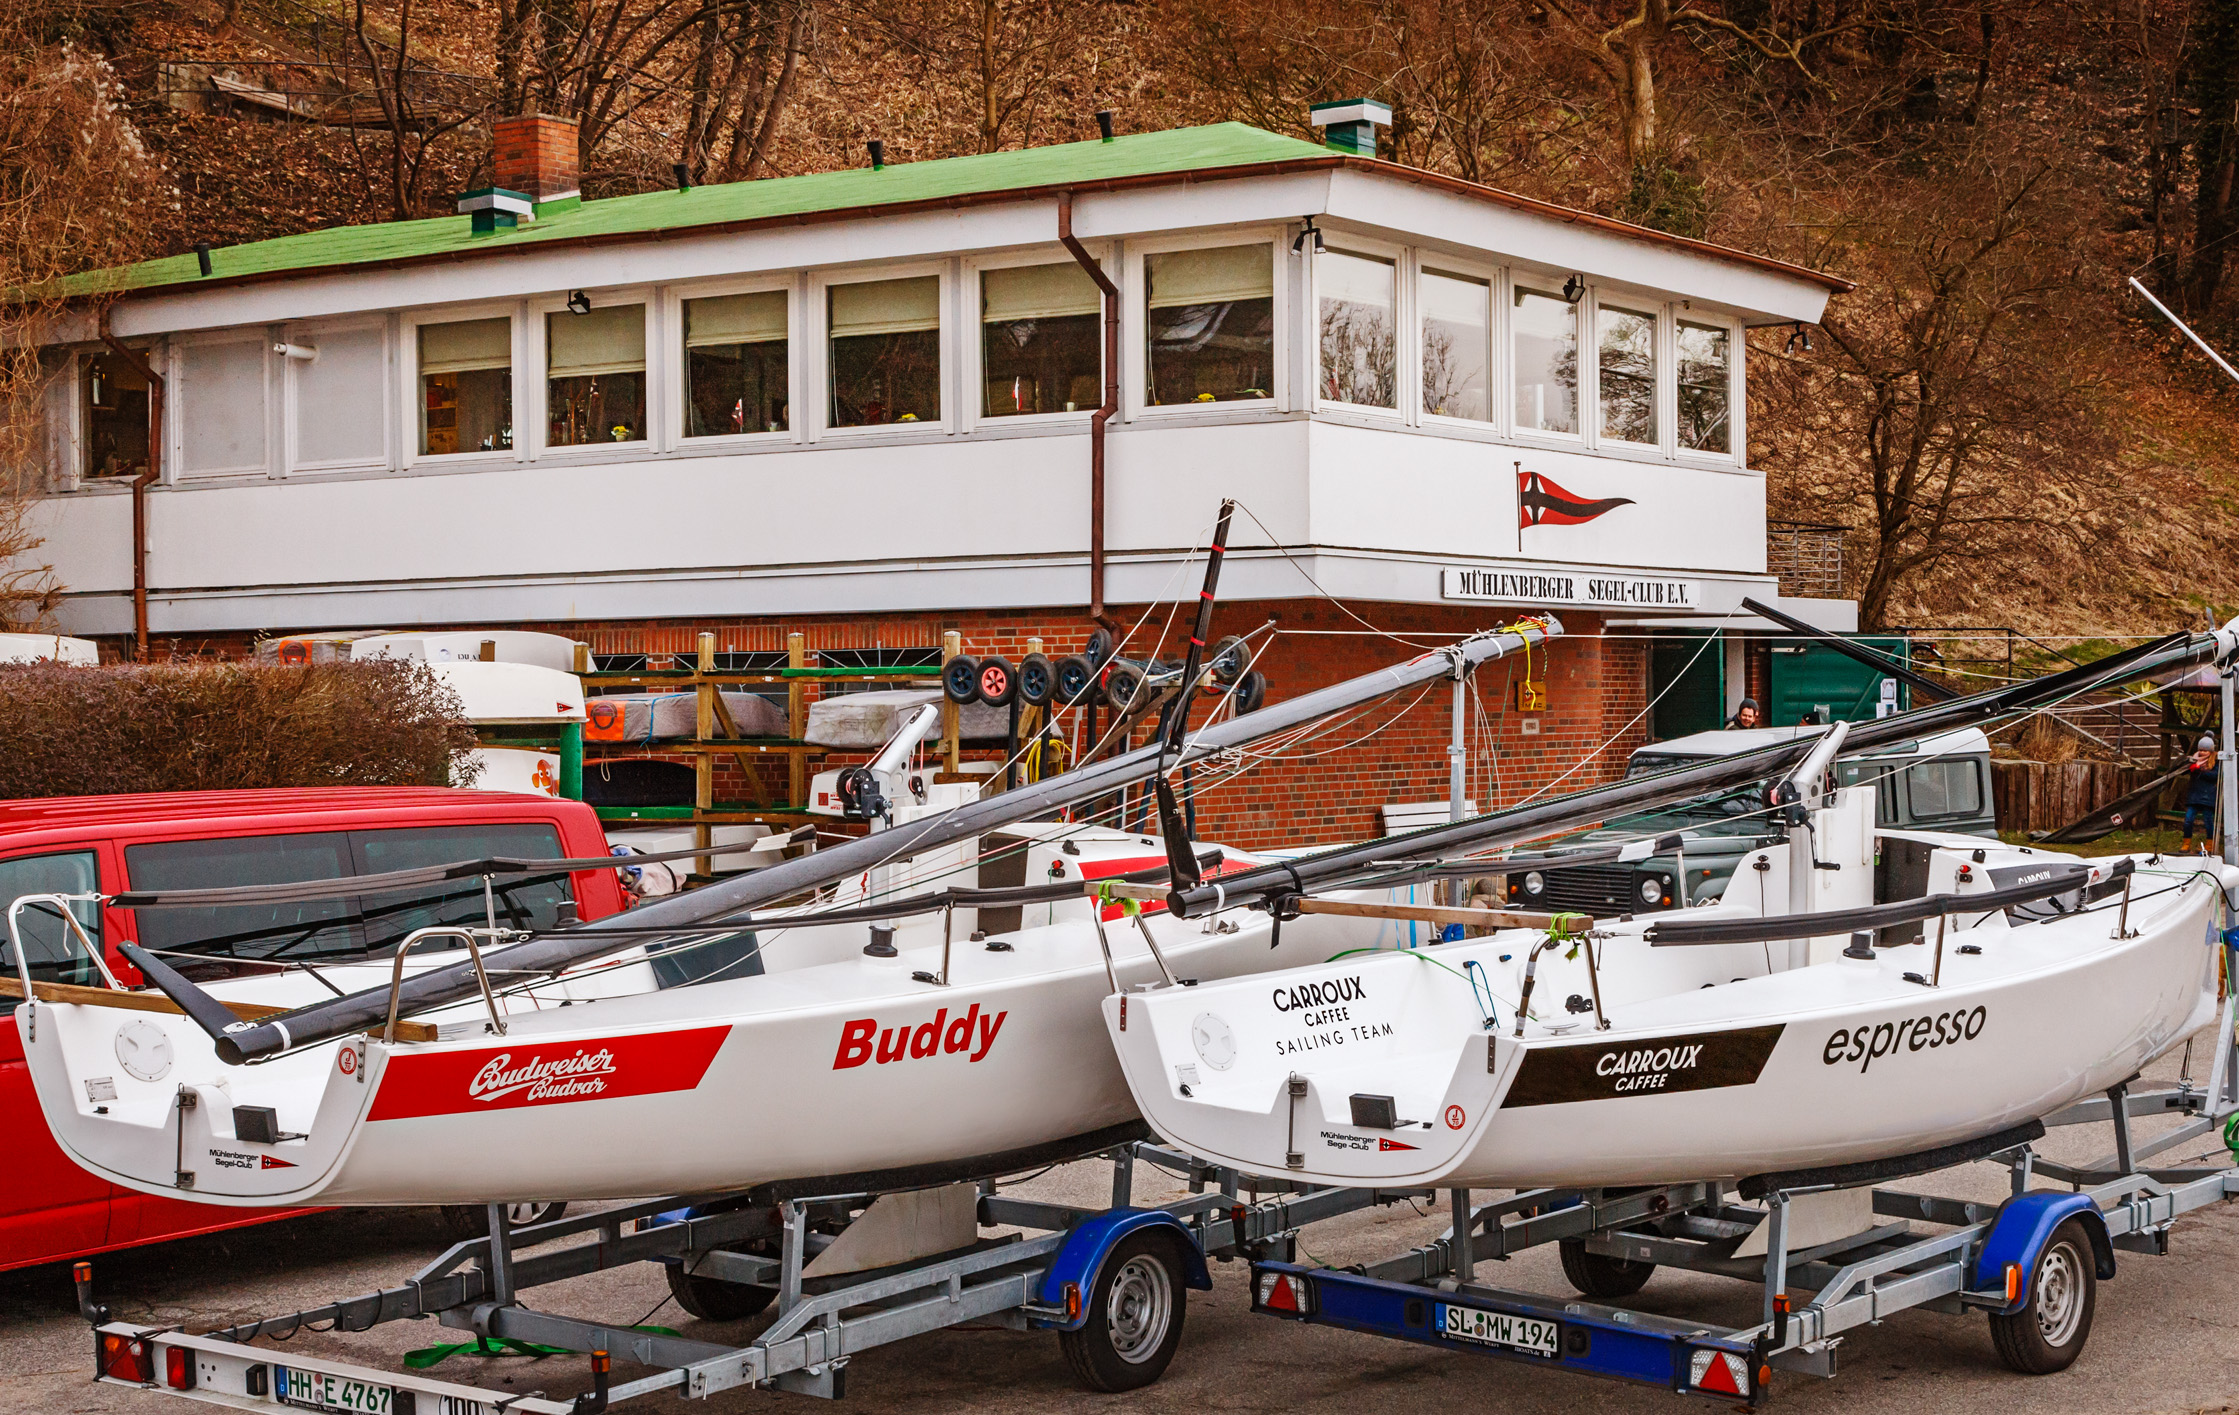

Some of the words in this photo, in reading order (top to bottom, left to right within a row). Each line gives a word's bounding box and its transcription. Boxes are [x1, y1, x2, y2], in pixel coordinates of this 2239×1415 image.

[1459, 568, 1574, 600] MÜHLENBERGER
[1588, 578, 1664, 604] SEGEL-CLUB
[1667, 583, 1689, 605] E.V.
[1272, 975, 1367, 1012] CARROUX
[1304, 1006, 1350, 1027] CAFFEE
[832, 1002, 1009, 1071] Buddy
[1276, 1030, 1344, 1056] SAILING
[1350, 1022, 1394, 1042] TEAM
[1822, 1005, 1987, 1074] espresso
[468, 1048, 617, 1097] Budweiser
[1595, 1044, 1704, 1077] CARROUX
[526, 1075, 608, 1101] Budvar
[1615, 1073, 1669, 1092] CAFFEE
[1320, 1131, 1377, 1144] Mühlenberger
[209, 1148, 260, 1163] Mühlenberger
[215, 1158, 253, 1169] Segel-Club
[1447, 1307, 1473, 1335] SL
[1486, 1314, 1513, 1342] MW
[1517, 1320, 1556, 1349] 194
[287, 1369, 312, 1400] HH
[324, 1377, 338, 1405] E
[341, 1381, 391, 1413] 4767
